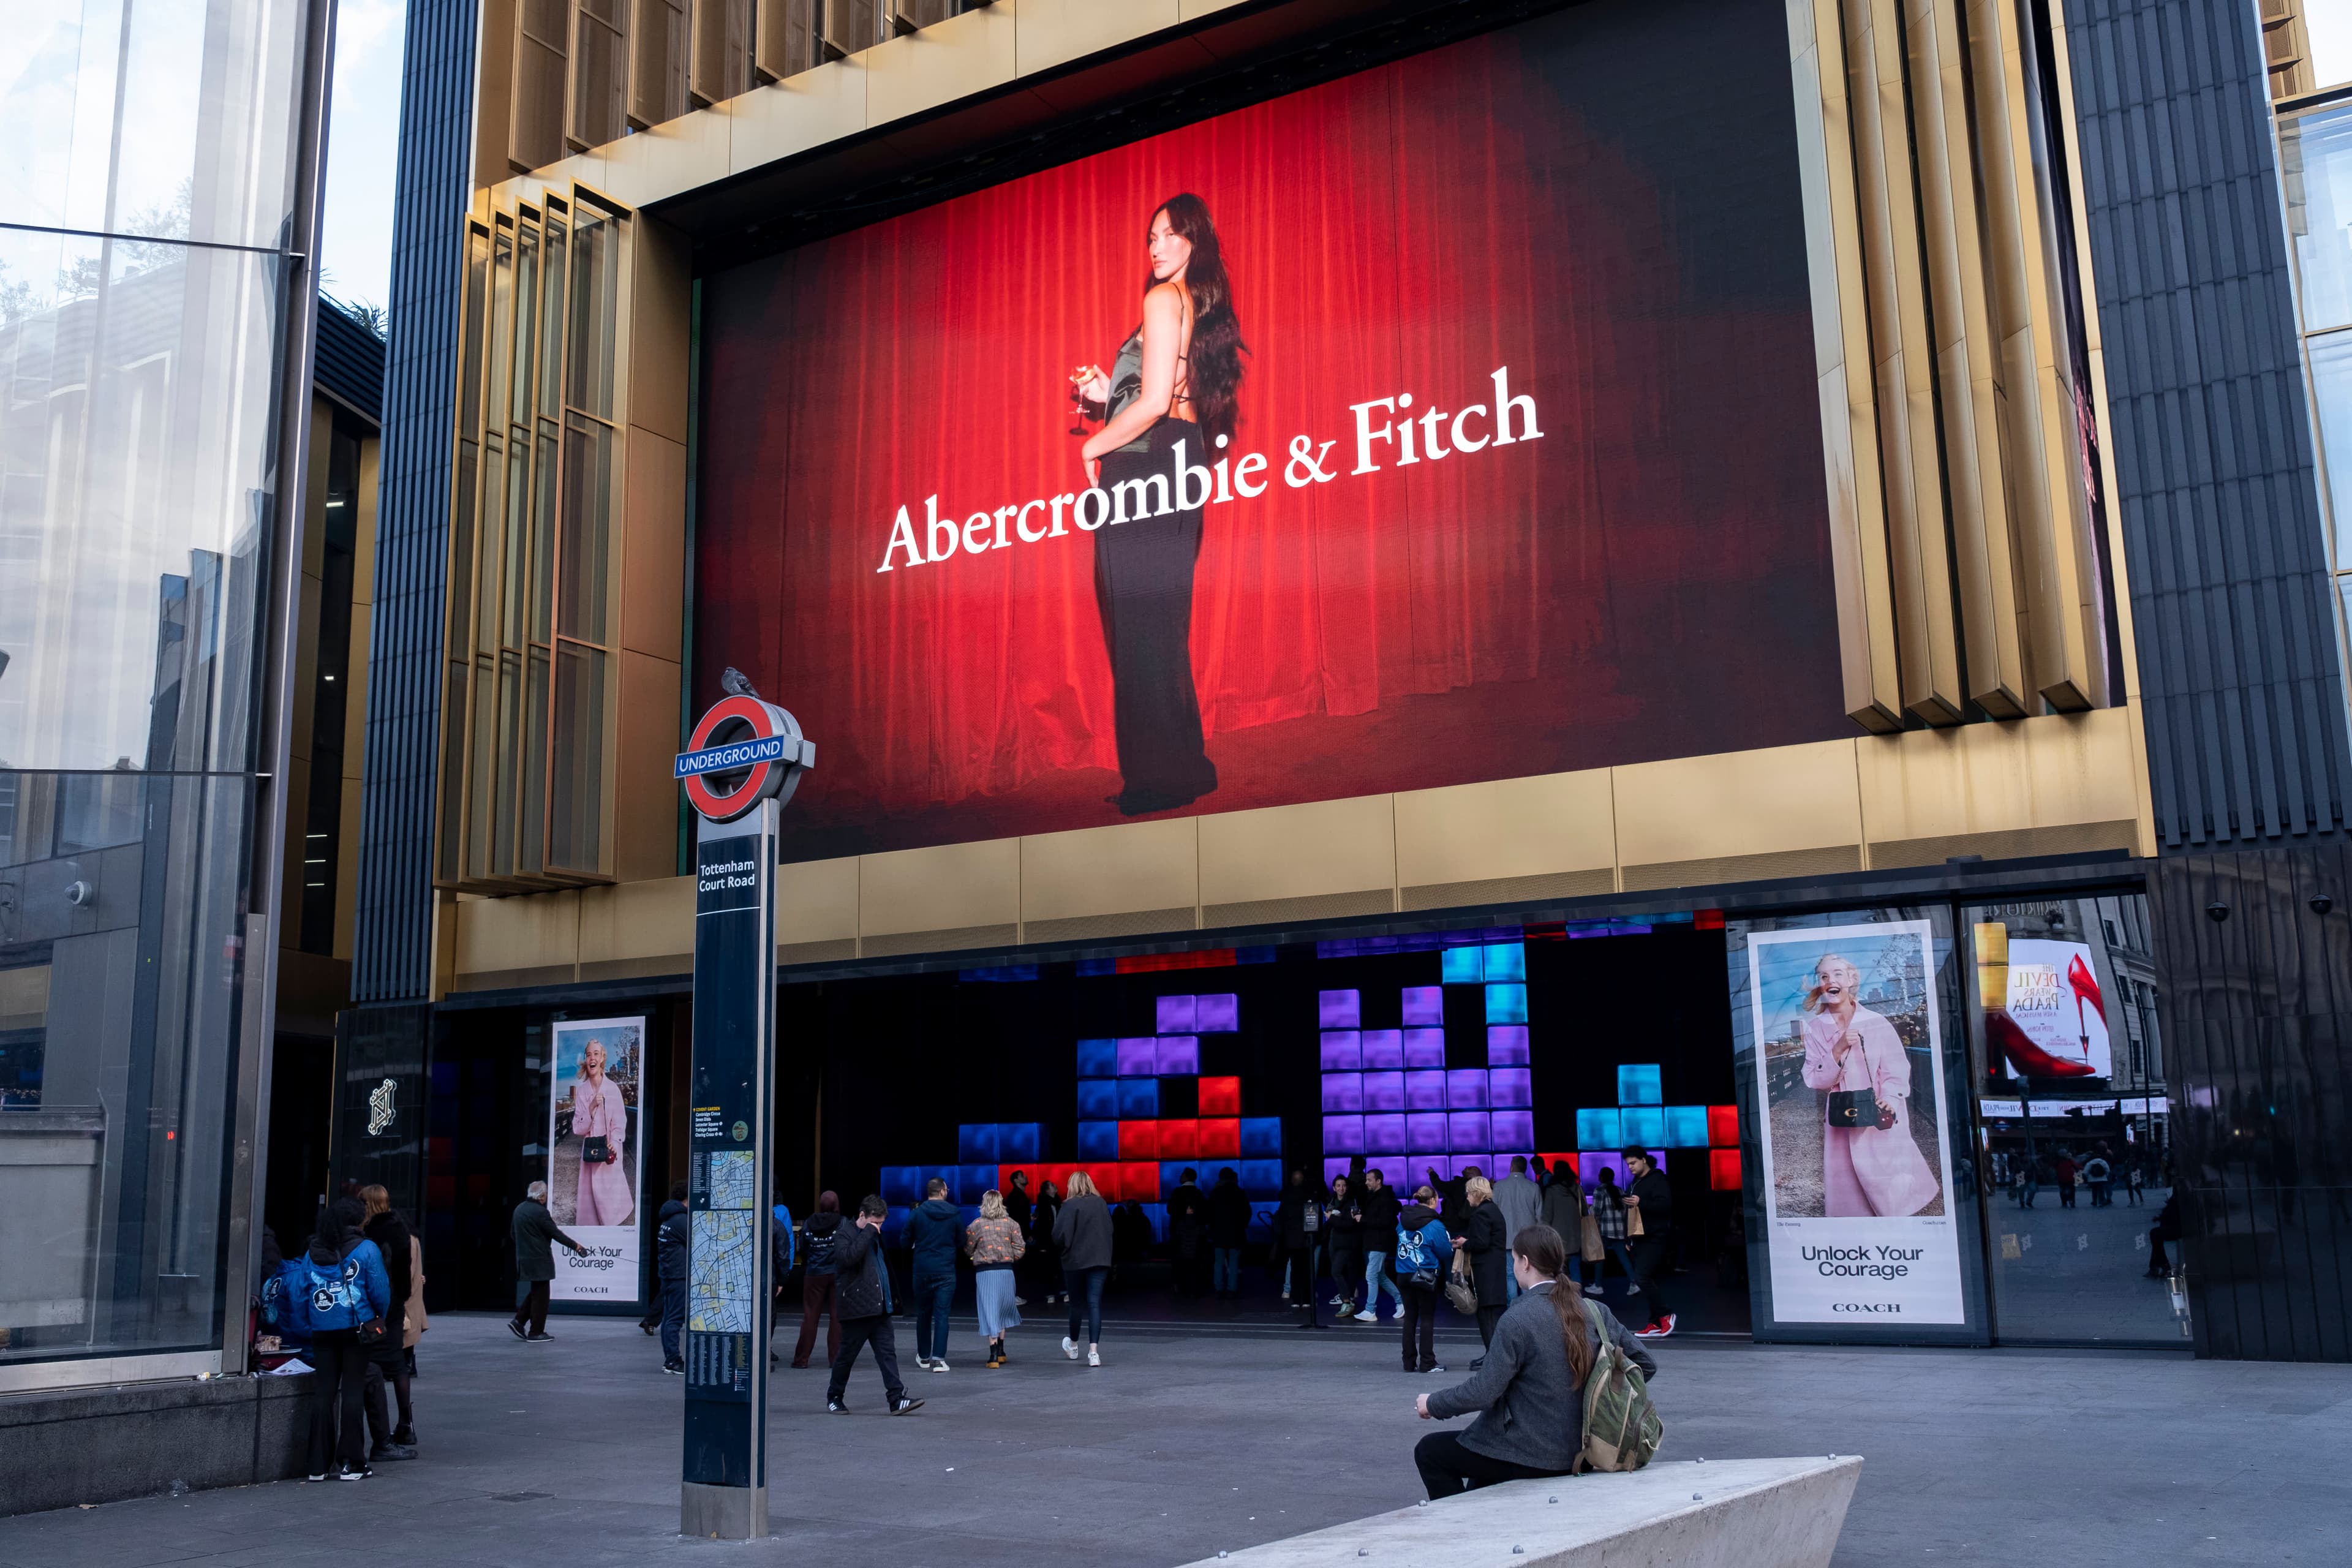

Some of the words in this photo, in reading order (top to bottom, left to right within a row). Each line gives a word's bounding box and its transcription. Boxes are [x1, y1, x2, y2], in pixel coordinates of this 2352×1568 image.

[877, 435, 1268, 575] Abercrombie
[1284, 435, 1337, 489] &
[1349, 365, 1545, 477] Fitch
[679, 741, 780, 772] UNDERGROUND
[700, 859, 755, 876] Tottenham
[699, 876, 725, 892] Court
[728, 874, 755, 888] Road
[562, 1246, 597, 1257] Unck
[598, 1246, 623, 1257] Your
[1802, 1245, 1872, 1261] Unlock
[1875, 1245, 1924, 1261] Your
[569, 1257, 614, 1270] Courage
[1818, 1262, 1908, 1280] Courage
[1832, 1303, 1901, 1313] COACH
